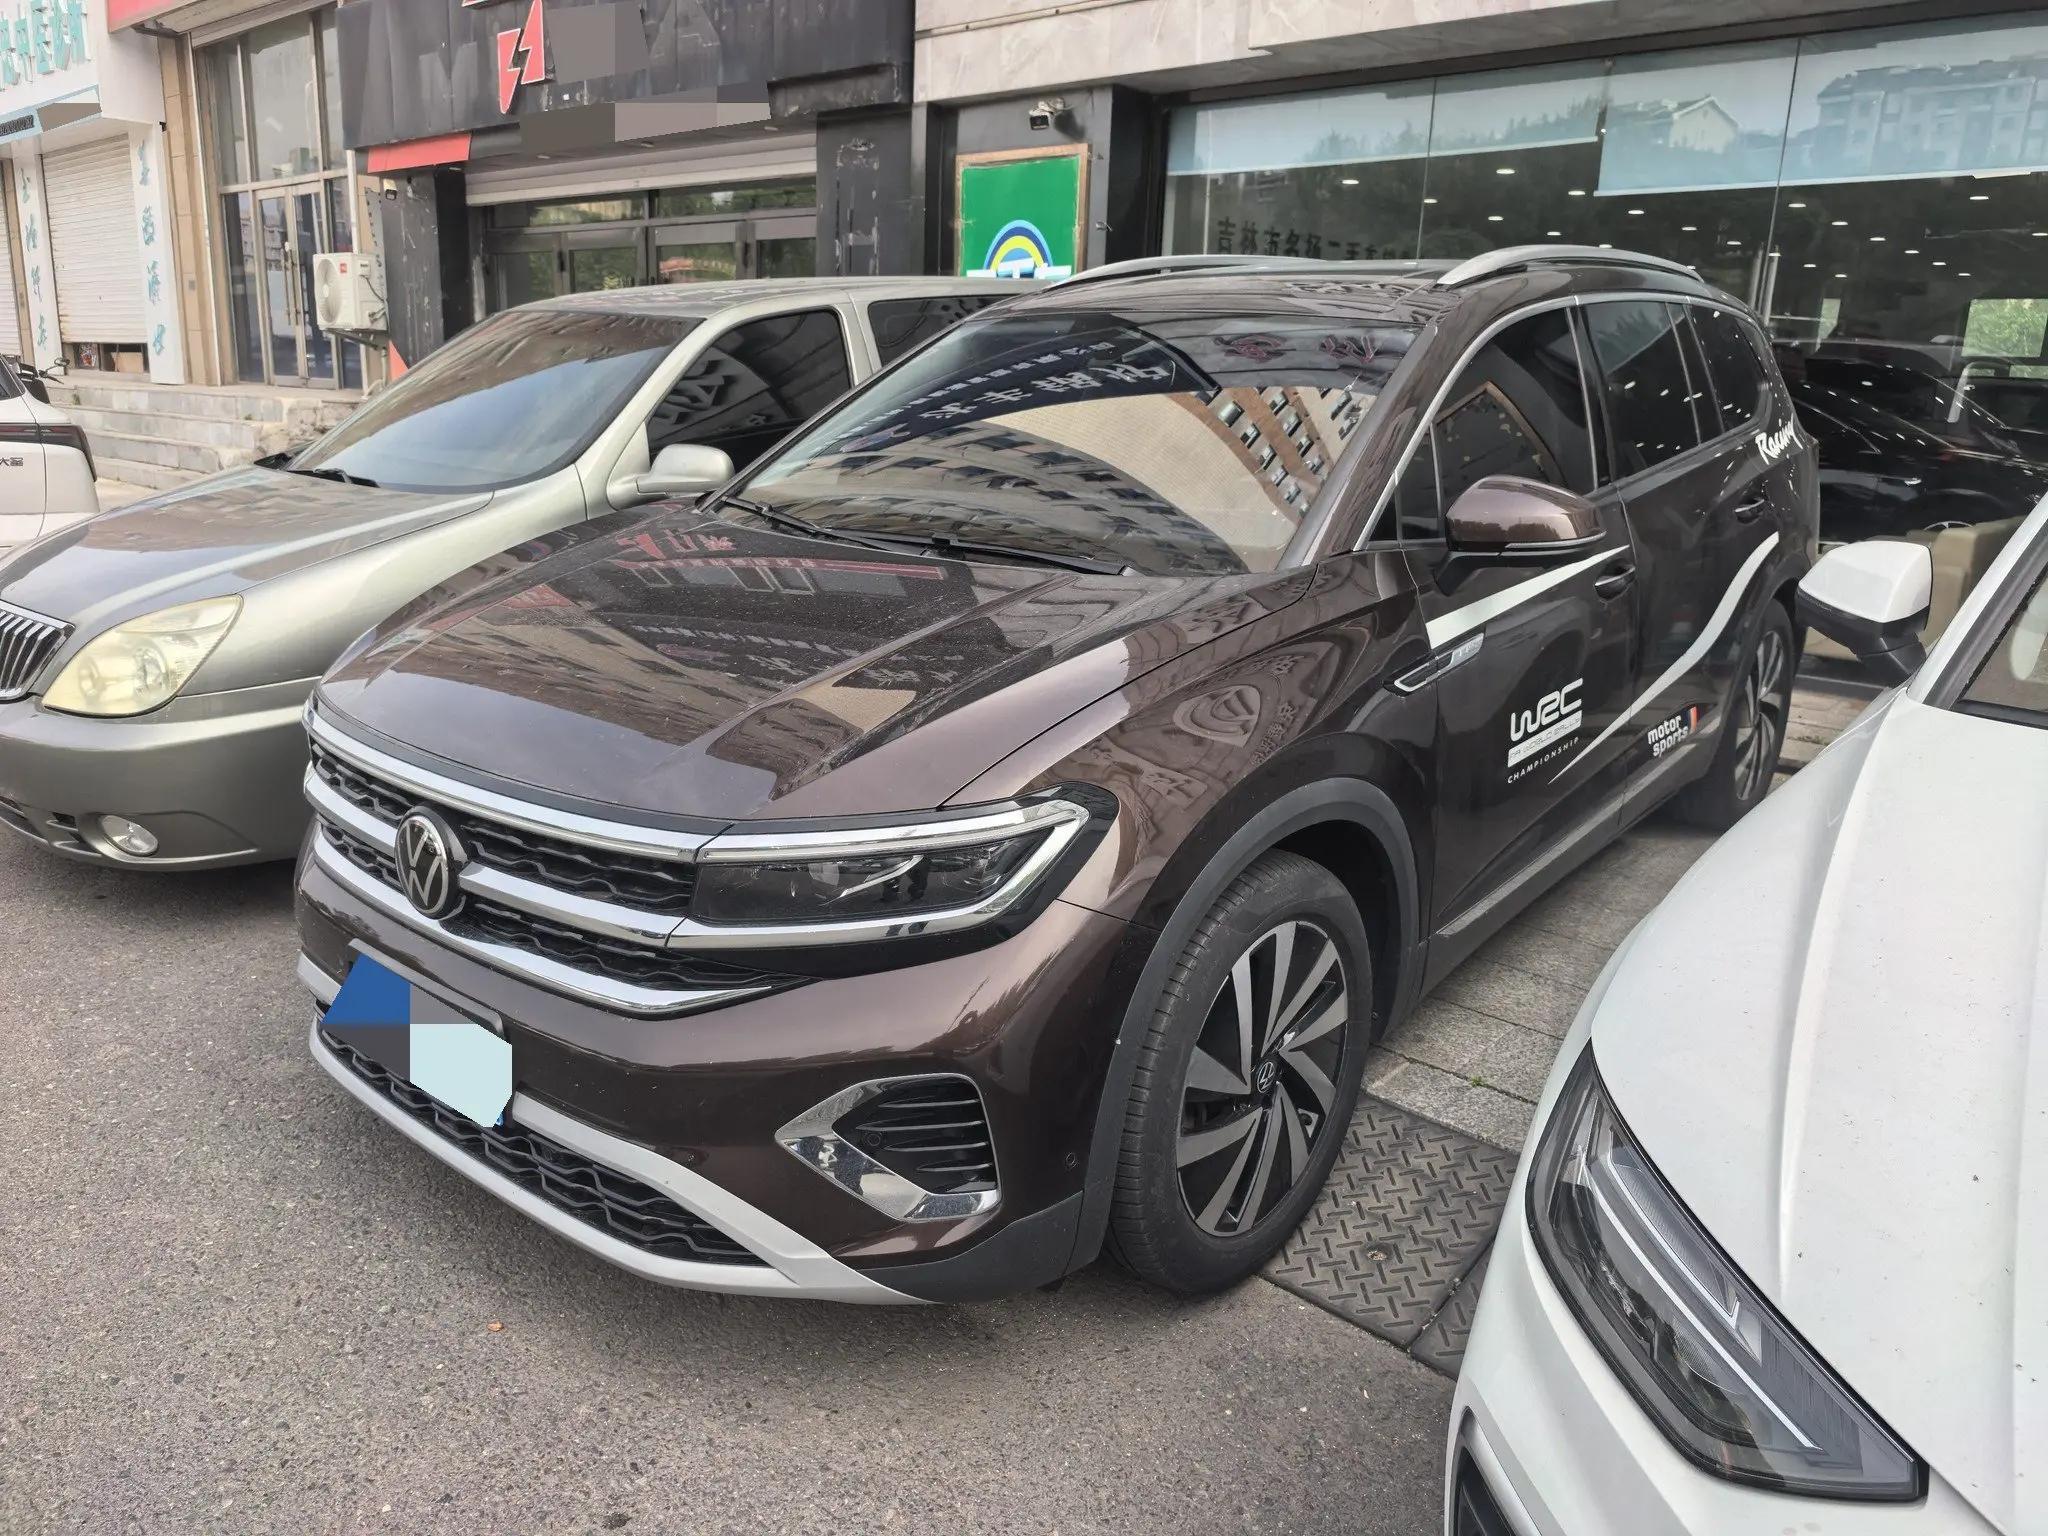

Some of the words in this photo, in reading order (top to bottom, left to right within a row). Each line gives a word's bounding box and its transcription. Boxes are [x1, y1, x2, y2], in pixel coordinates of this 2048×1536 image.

[1510, 677, 1583, 742] WRC
[1648, 715, 1682, 744] motor
[1653, 726, 1689, 757] sports
[1507, 736, 1579, 783] CHAMPIONSHIP
